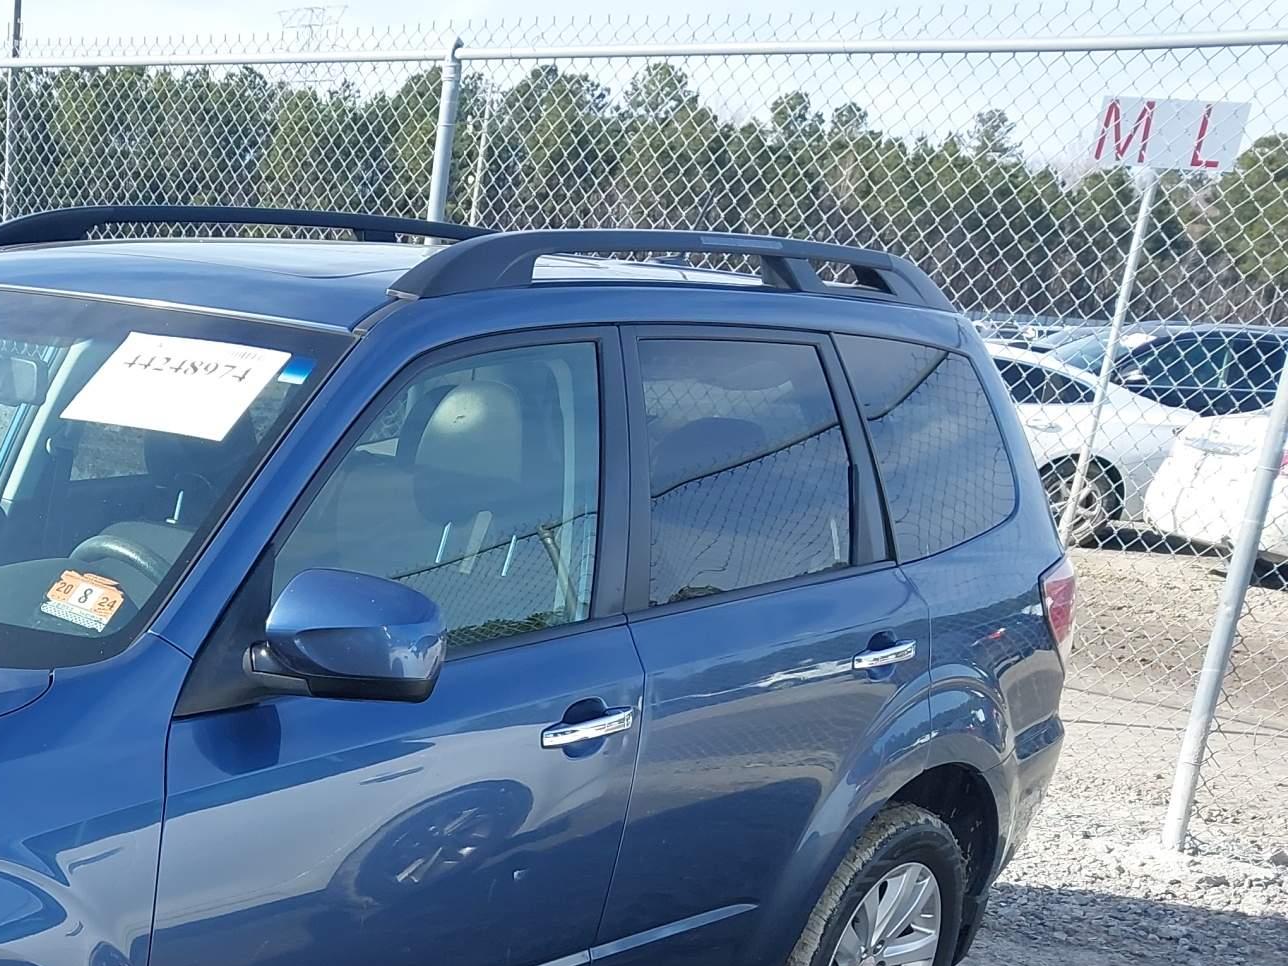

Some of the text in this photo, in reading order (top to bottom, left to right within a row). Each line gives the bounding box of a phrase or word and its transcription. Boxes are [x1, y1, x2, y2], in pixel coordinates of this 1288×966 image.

[1094, 99, 1220, 167] M L
[124, 354, 253, 383] 44248974
[56, 582, 117, 611] 20 8 24
